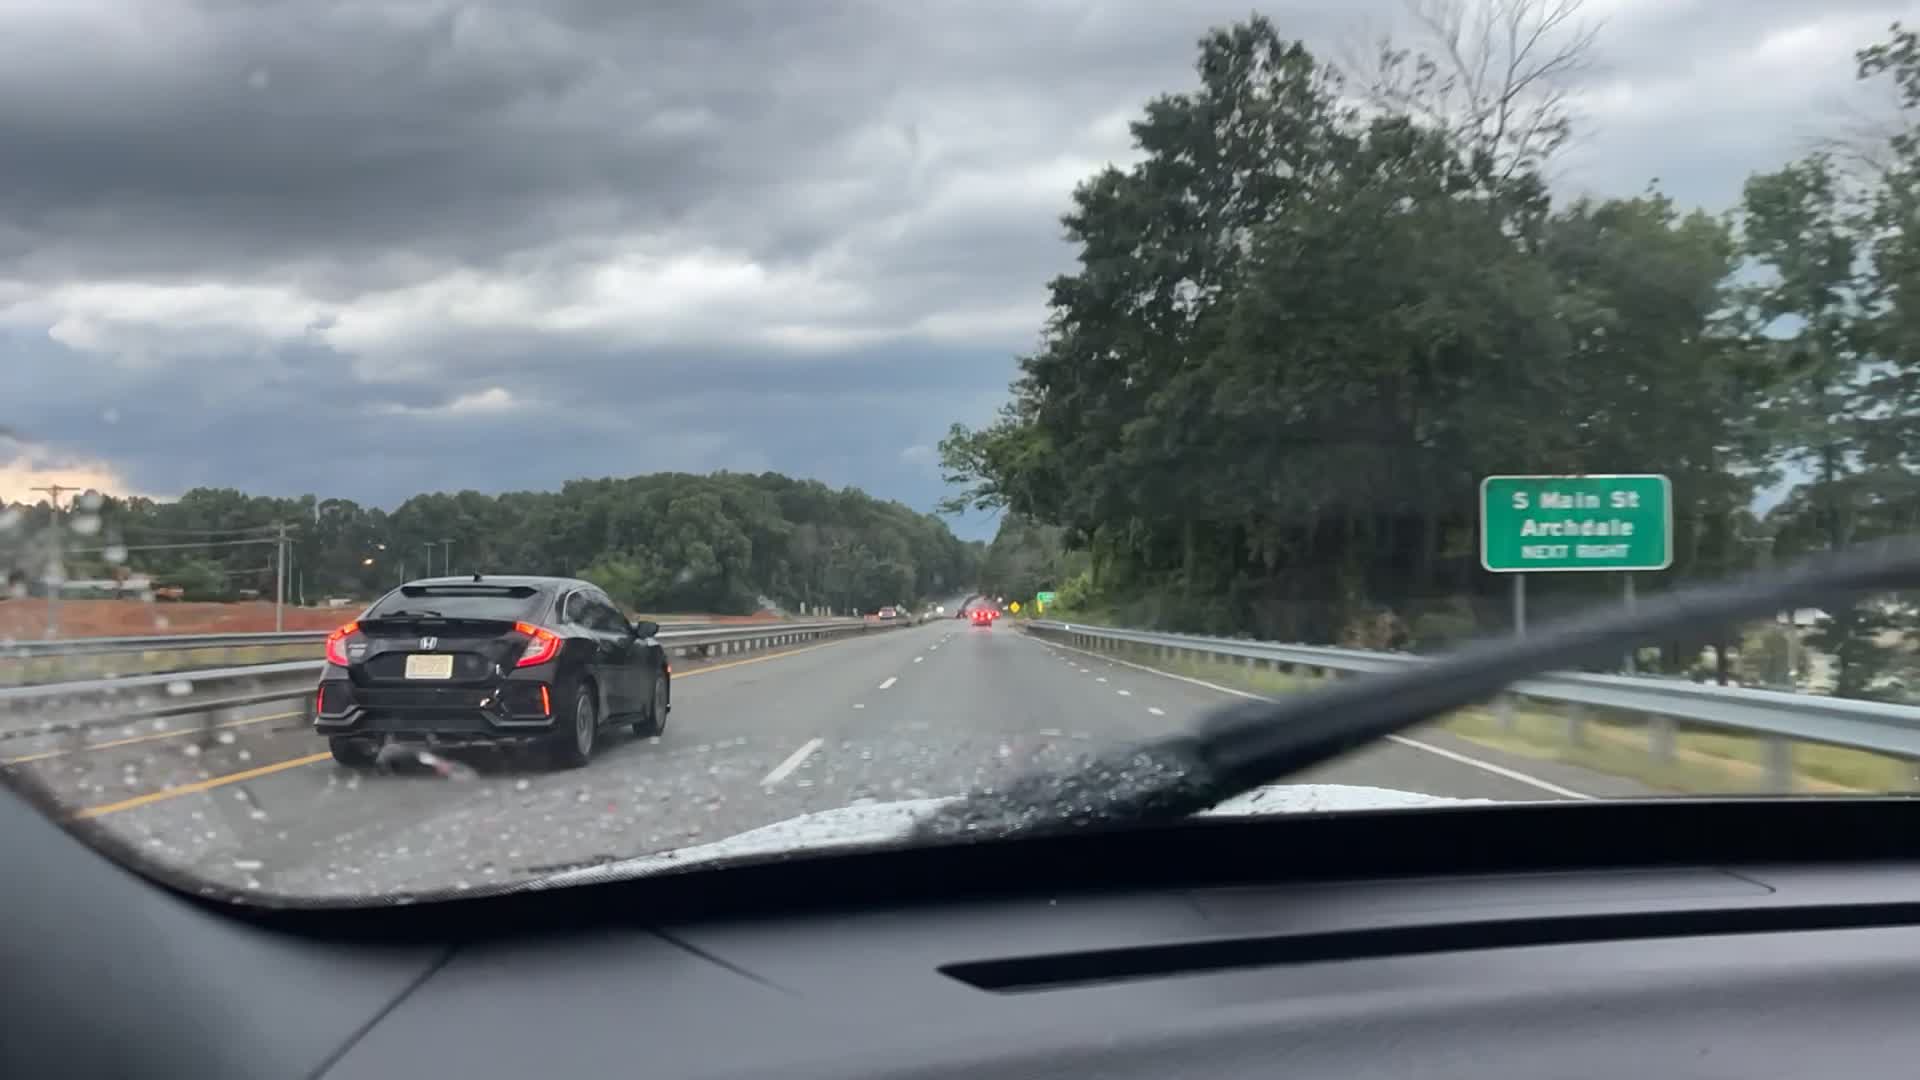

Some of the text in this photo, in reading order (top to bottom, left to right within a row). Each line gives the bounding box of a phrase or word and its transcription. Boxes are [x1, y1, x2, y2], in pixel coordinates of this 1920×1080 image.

[1512, 490, 1640, 509] S Main St
[1520, 519, 1634, 536] Archdale
[1521, 545, 1568, 559] NEXT
